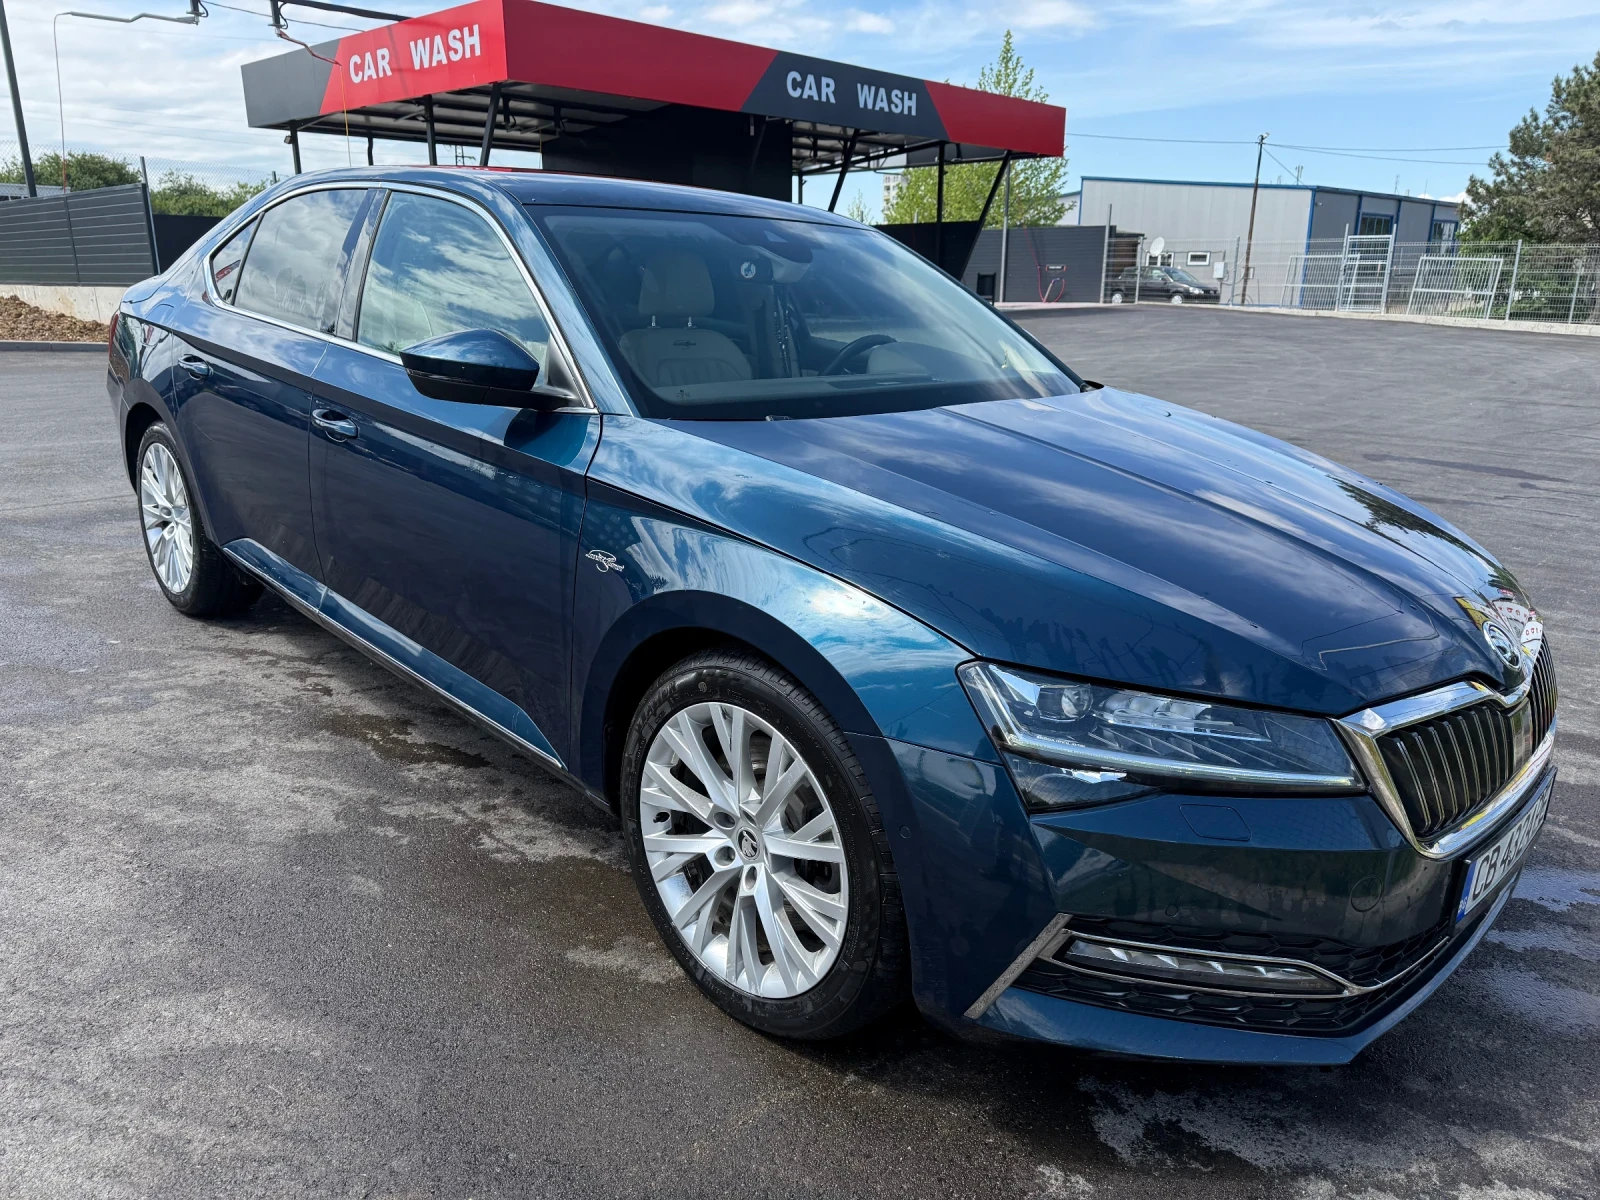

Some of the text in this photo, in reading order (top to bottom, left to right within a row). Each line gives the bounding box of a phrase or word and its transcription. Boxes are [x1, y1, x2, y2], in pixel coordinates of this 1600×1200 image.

[349, 24, 480, 84] CAR WASH
[786, 70, 917, 116] CAR WASH
[1472, 845, 1501, 901] CB
